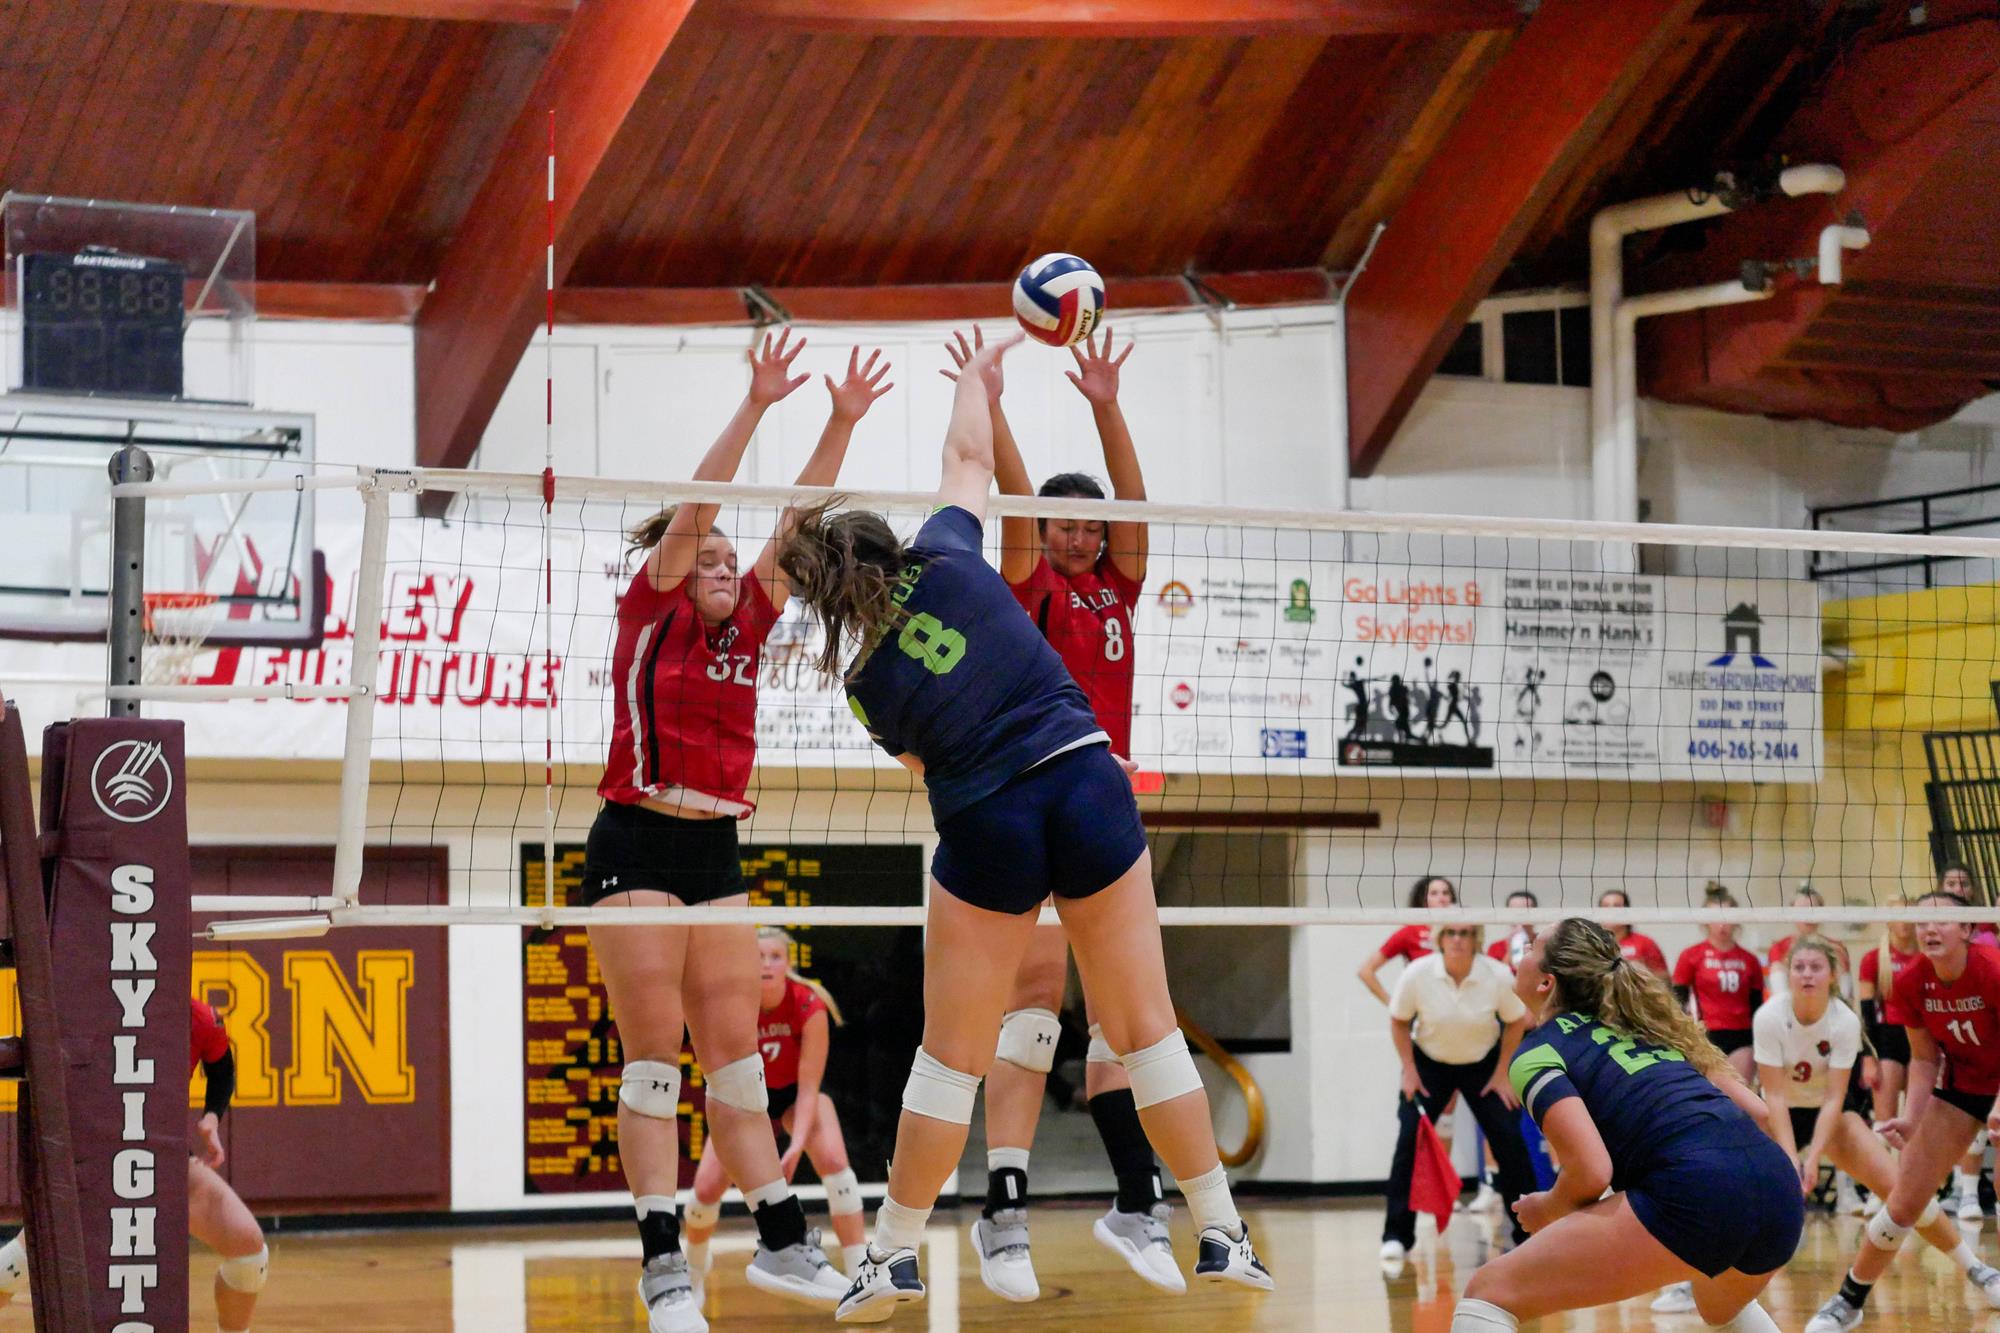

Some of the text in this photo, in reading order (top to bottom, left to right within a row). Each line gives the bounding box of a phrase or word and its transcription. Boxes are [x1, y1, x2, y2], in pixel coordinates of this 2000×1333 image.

[1344, 577, 1482, 614] Go Lights &
[898, 612, 967, 674] 8
[1104, 616, 1125, 662] 8
[1356, 617, 1473, 652] Skylights!
[1924, 995, 1985, 1013] BULLDOGS
[1946, 1019, 1981, 1047] 11
[762, 1042, 781, 1063] 7
[108, 864, 158, 1333] SKYLIGHT
